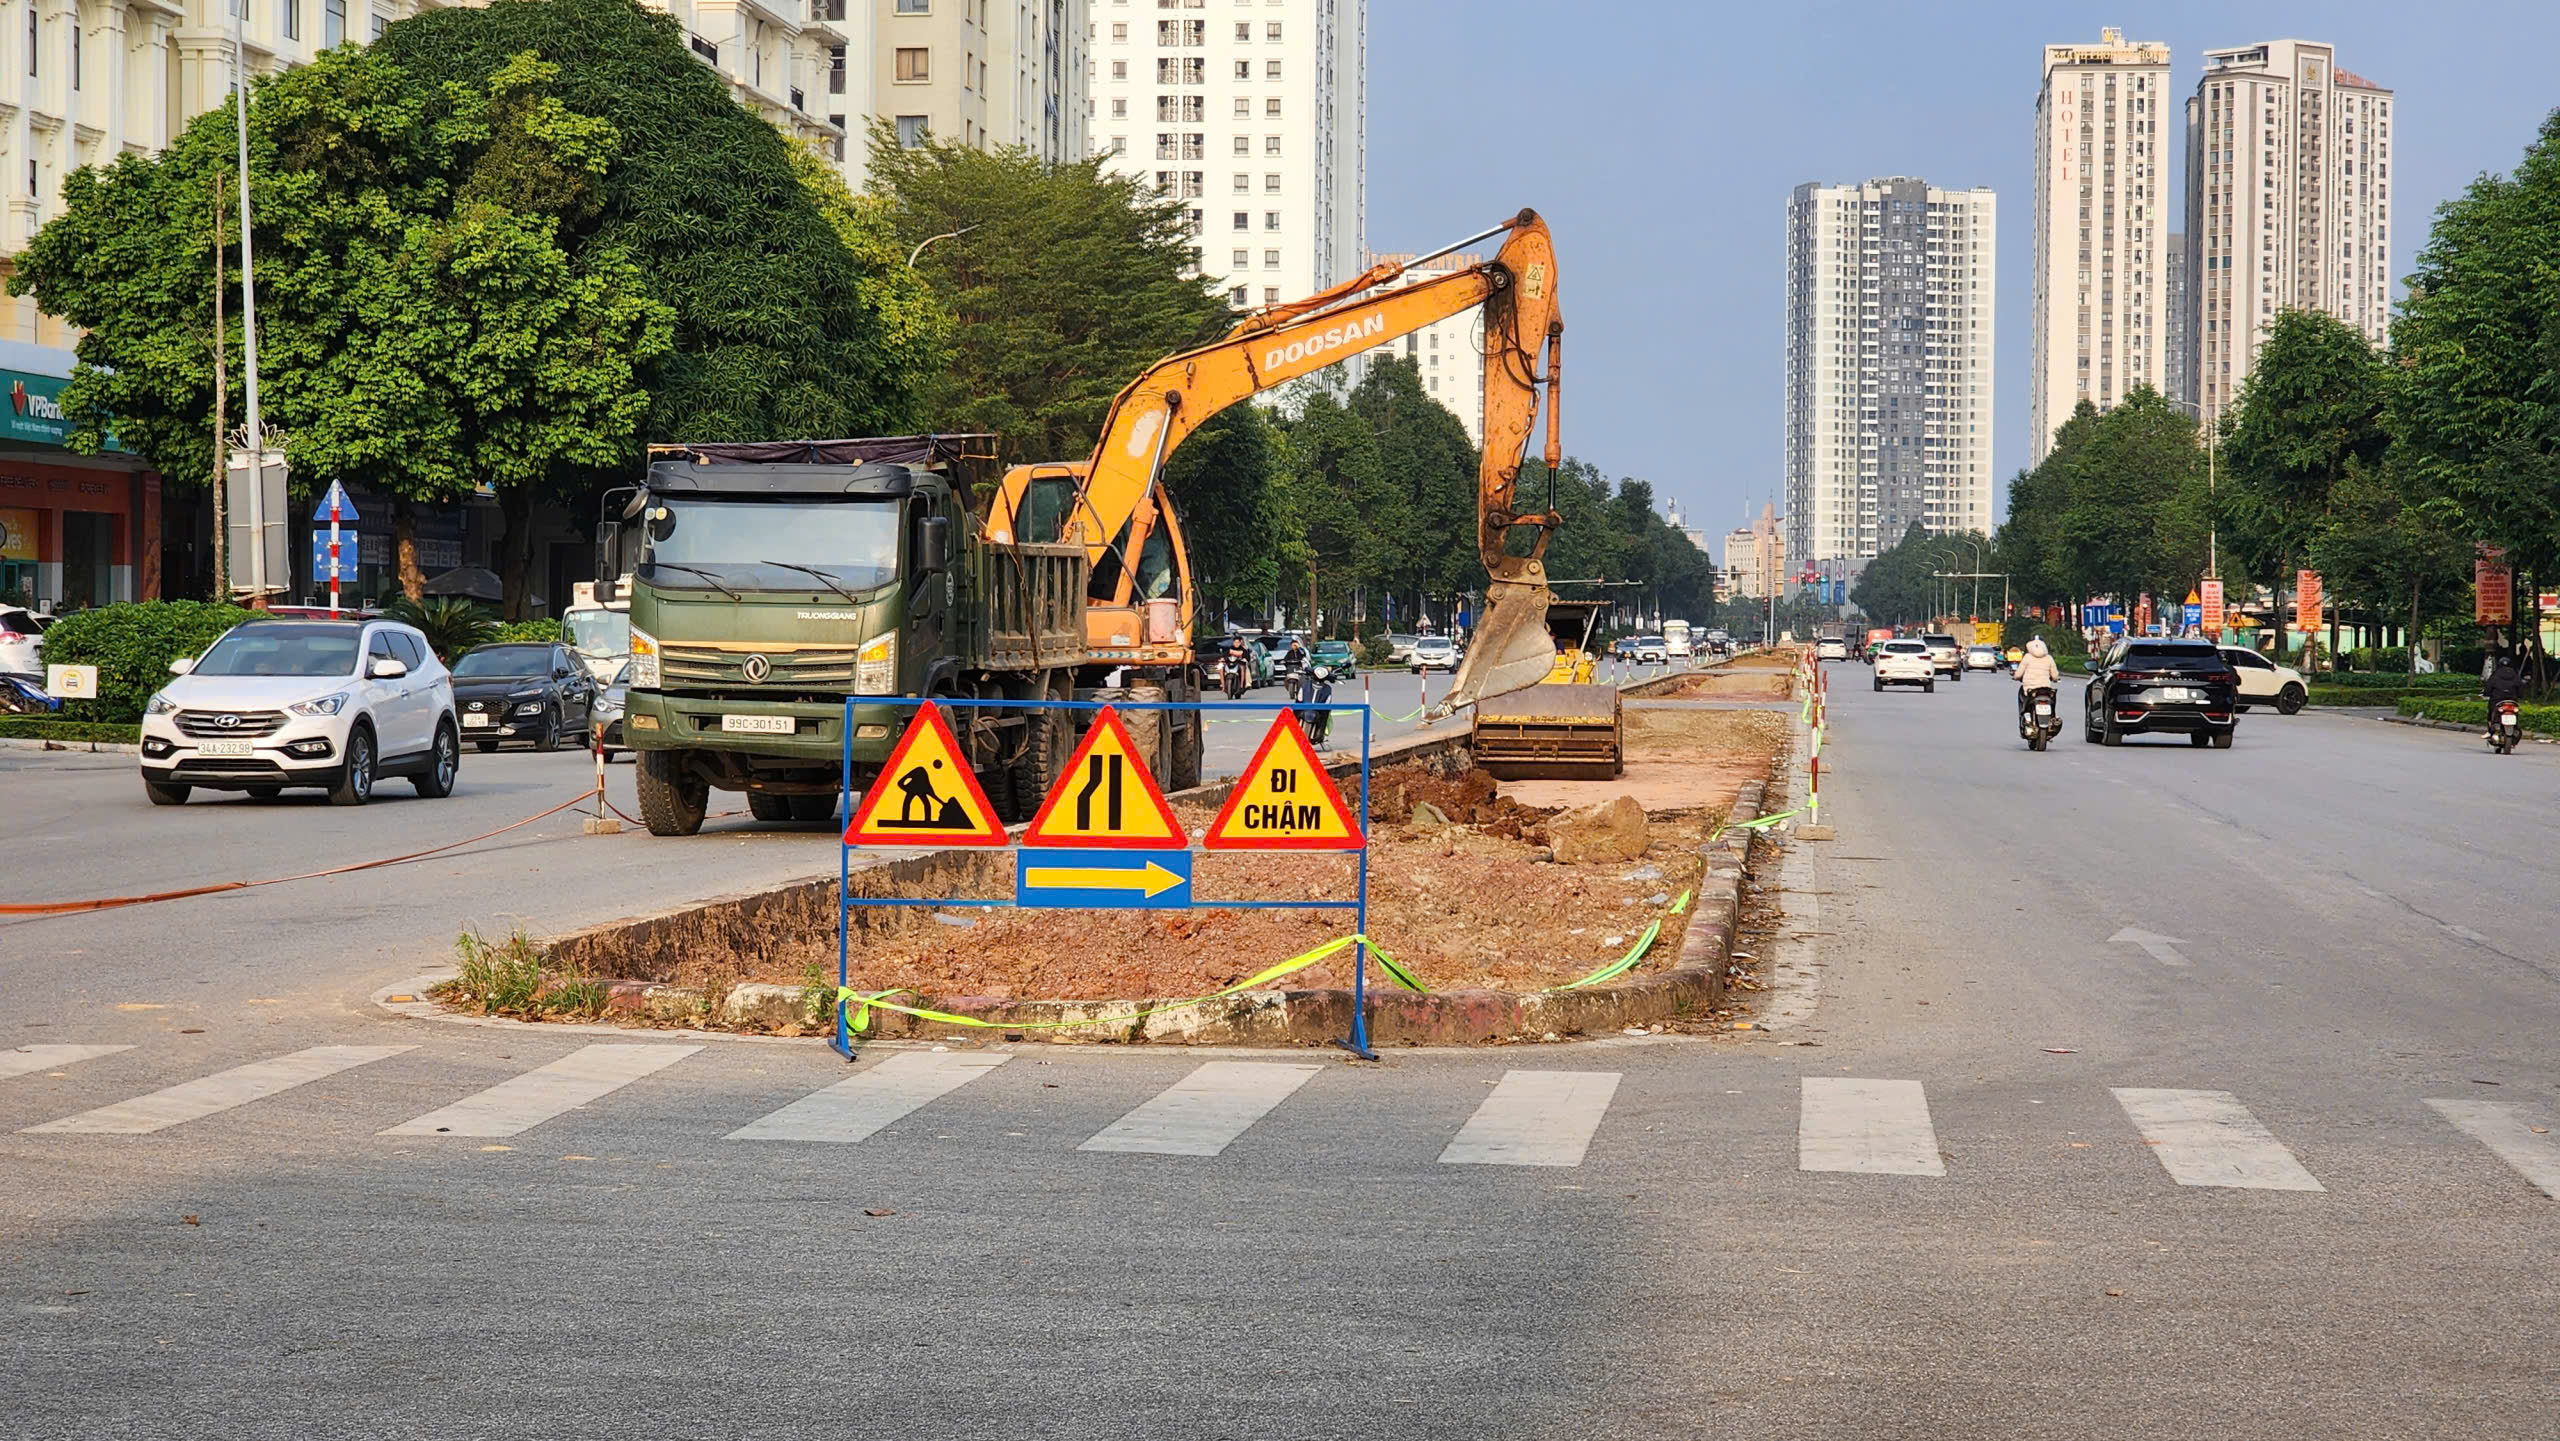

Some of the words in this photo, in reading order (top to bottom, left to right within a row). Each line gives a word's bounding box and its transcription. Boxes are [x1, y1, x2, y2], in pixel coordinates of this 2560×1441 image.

[2061, 91, 2073, 180] HOTEL
[1264, 312, 1385, 372] DOOSAN
[1270, 769, 1296, 793] ĐI
[1244, 800, 1321, 835] CHẬM
